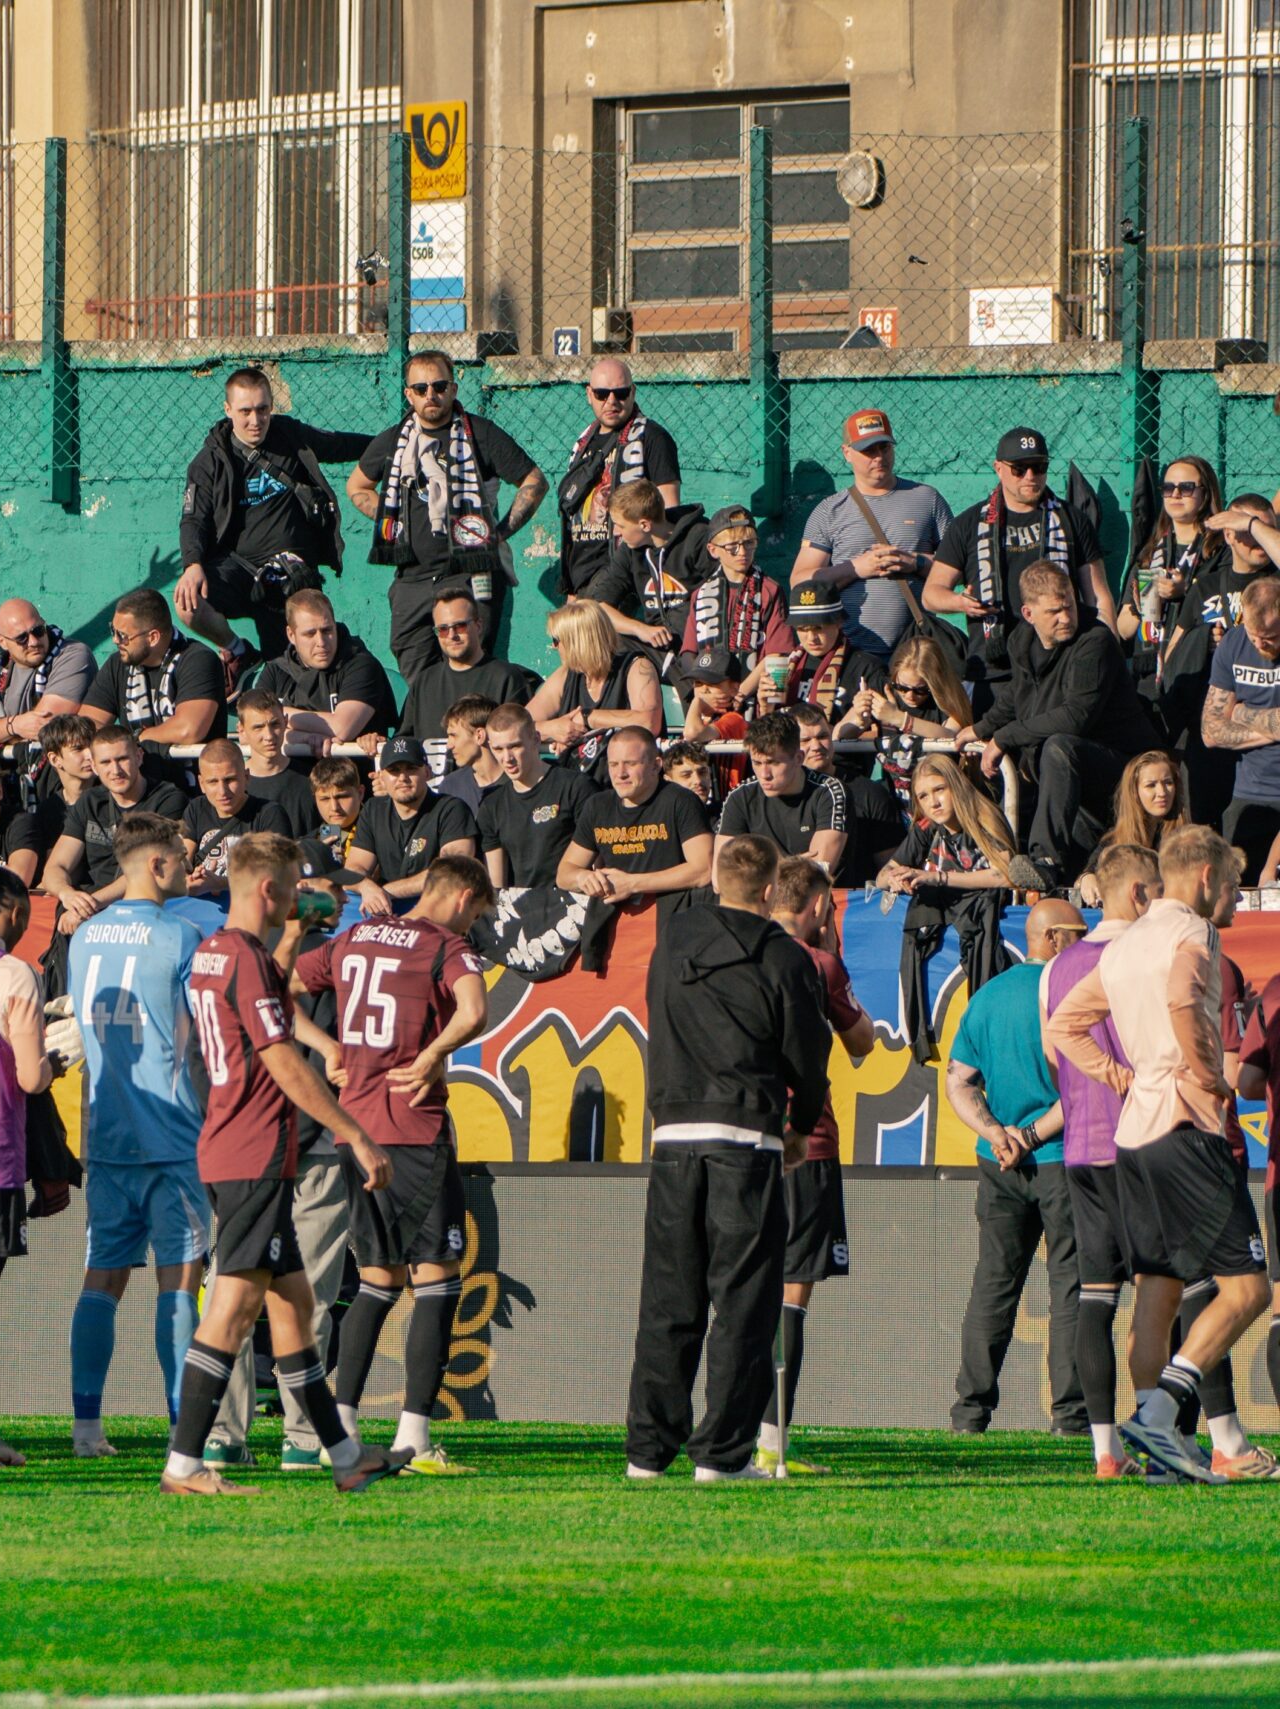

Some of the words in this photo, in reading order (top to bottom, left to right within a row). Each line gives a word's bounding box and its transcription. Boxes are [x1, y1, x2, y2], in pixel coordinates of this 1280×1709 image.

[865, 312, 893, 333] 846
[558, 334, 572, 356] 22
[1020, 436, 1036, 449] 39
[696, 579, 720, 642] KUR
[594, 823, 668, 844] PROPAGANDA
[85, 920, 152, 945] SUROVČÍK
[82, 955, 148, 1044] 44
[341, 953, 401, 1048] 25
